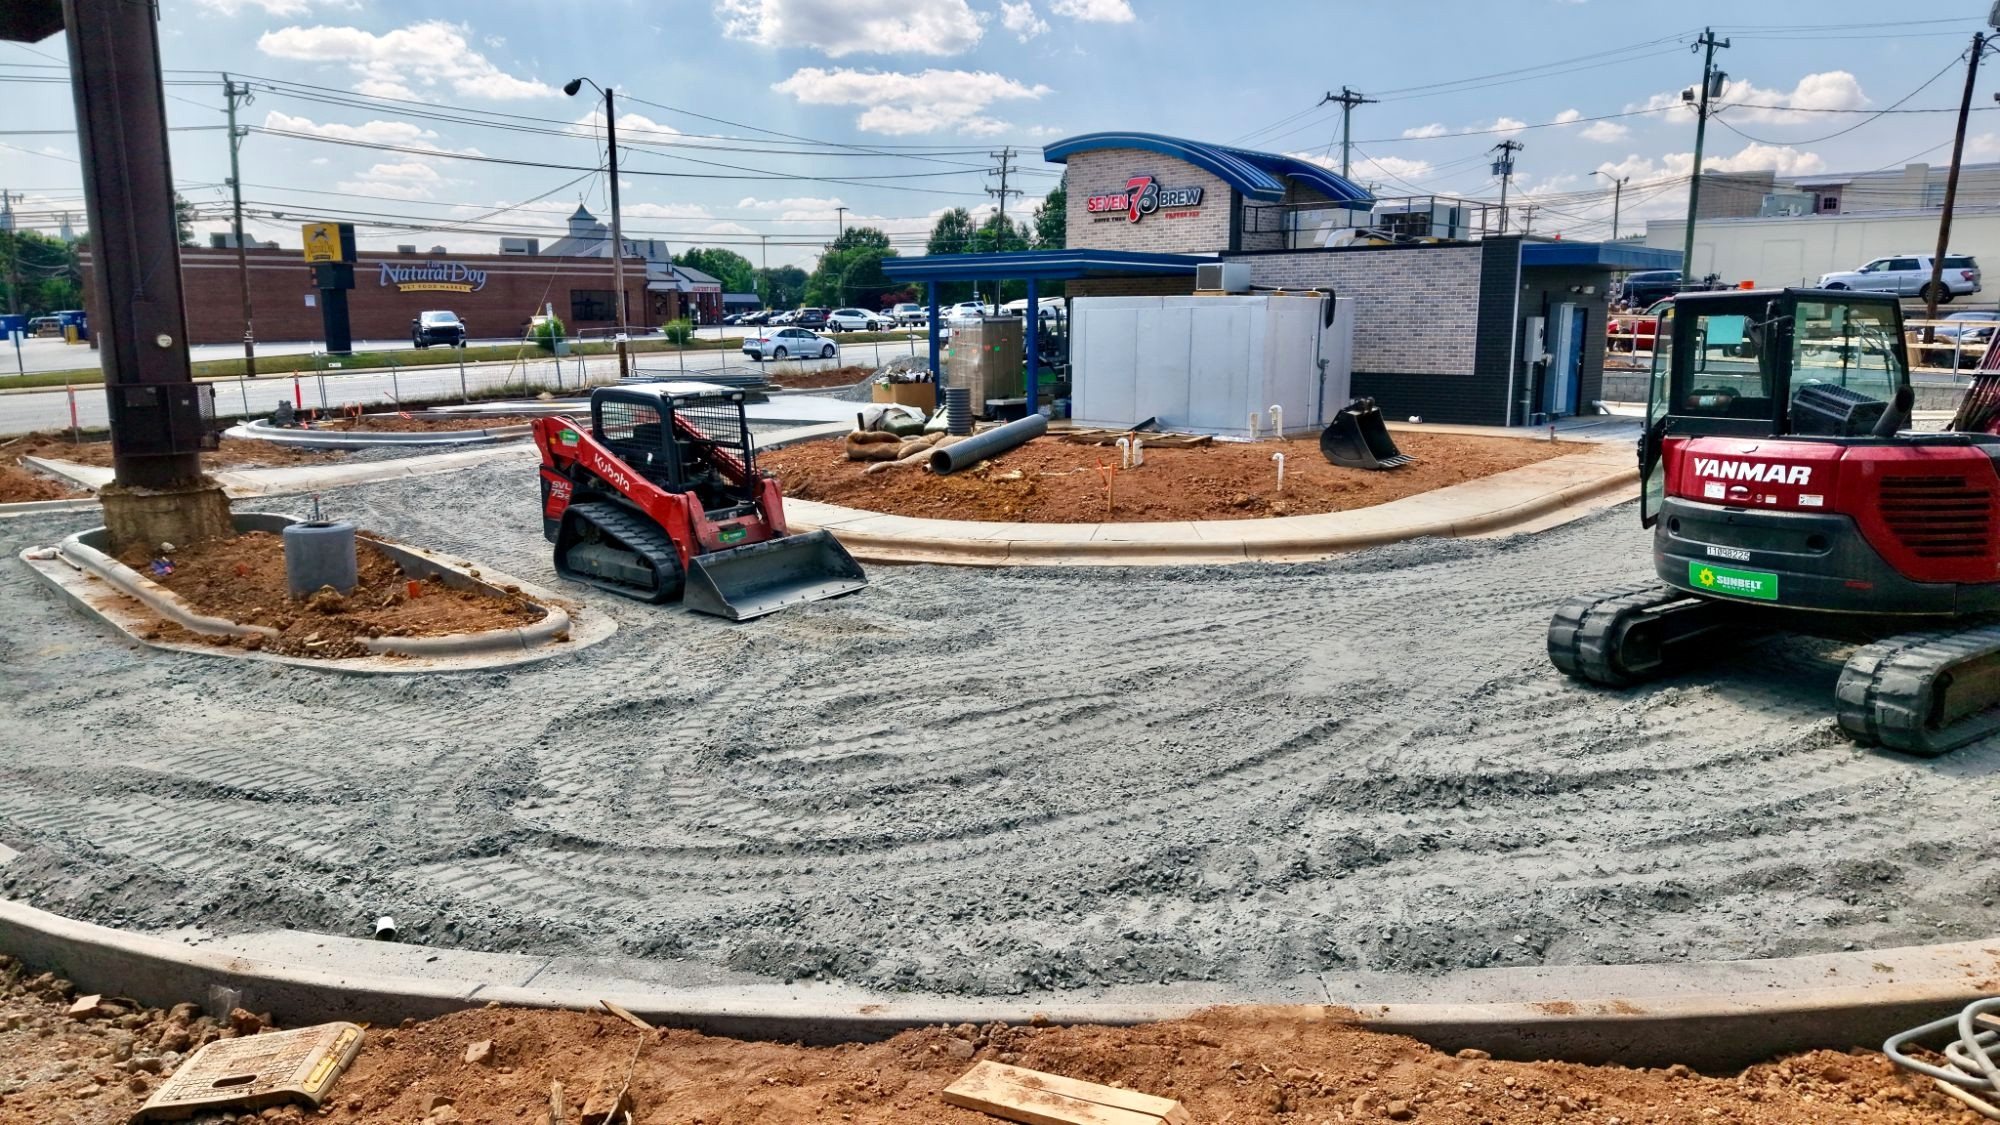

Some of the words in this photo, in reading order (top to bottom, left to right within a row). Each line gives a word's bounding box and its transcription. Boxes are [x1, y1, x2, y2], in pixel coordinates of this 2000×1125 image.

[1087, 193, 1129, 212] SEVEN
[1159, 188, 1201, 207] BREW
[379, 262, 449, 287] Natural
[450, 263, 488, 292] Dog
[594, 453, 630, 491] Kubota
[1693, 457, 1812, 486] YANMAR
[551, 480, 572, 491] SVL
[1716, 575, 1763, 590] SUNBELT
[1722, 584, 1756, 593] RENTALS
